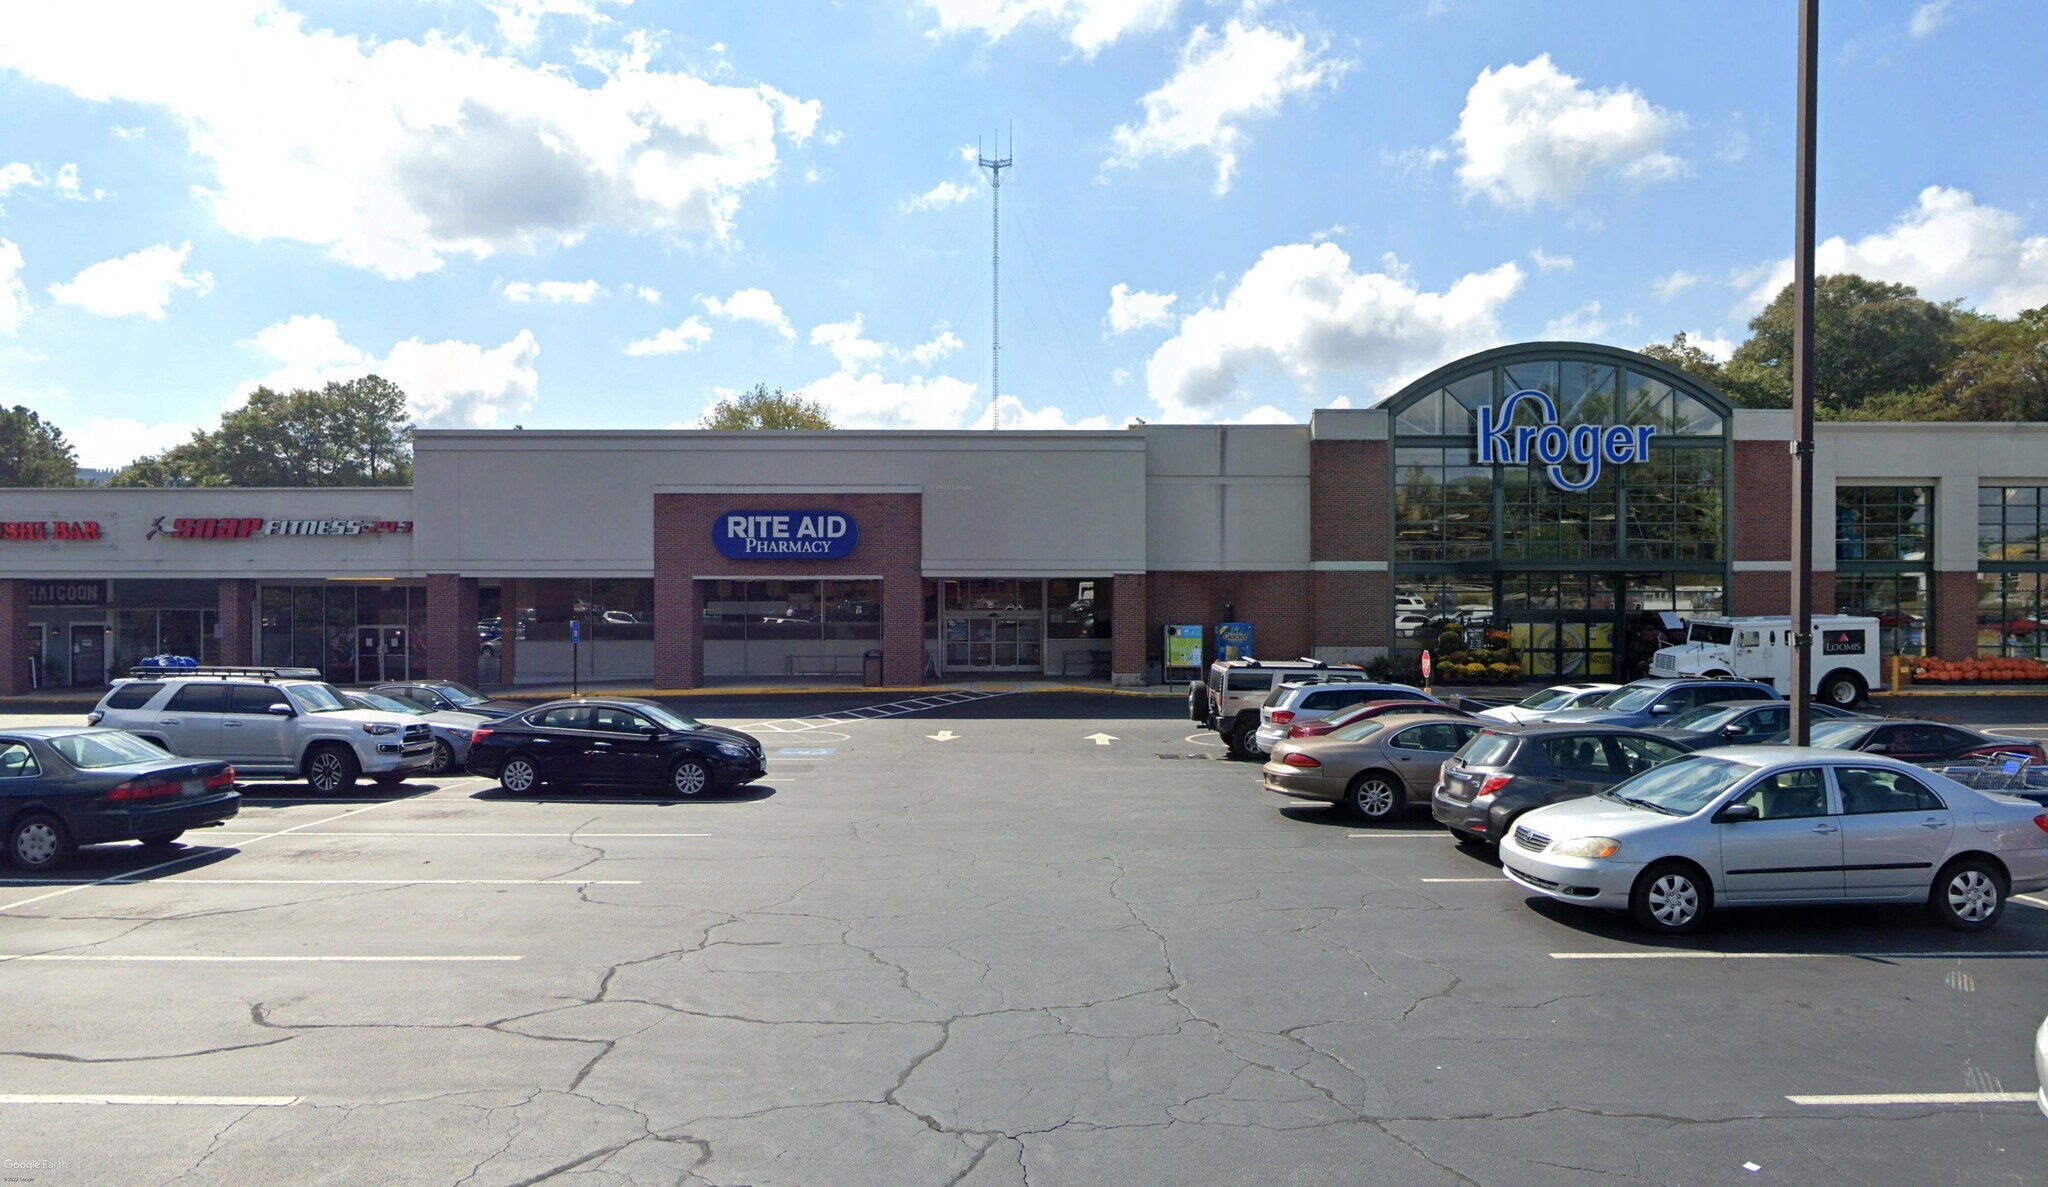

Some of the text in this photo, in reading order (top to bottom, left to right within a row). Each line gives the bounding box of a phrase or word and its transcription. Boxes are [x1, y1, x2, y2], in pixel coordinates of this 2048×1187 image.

[1477, 389, 1656, 492] Kroger
[53, 521, 101, 540] BAR
[264, 520, 362, 535] FITNESS
[728, 516, 847, 538] RITE AID
[745, 537, 832, 553] PHARMACY
[1826, 642, 1862, 652] LOOMIS
